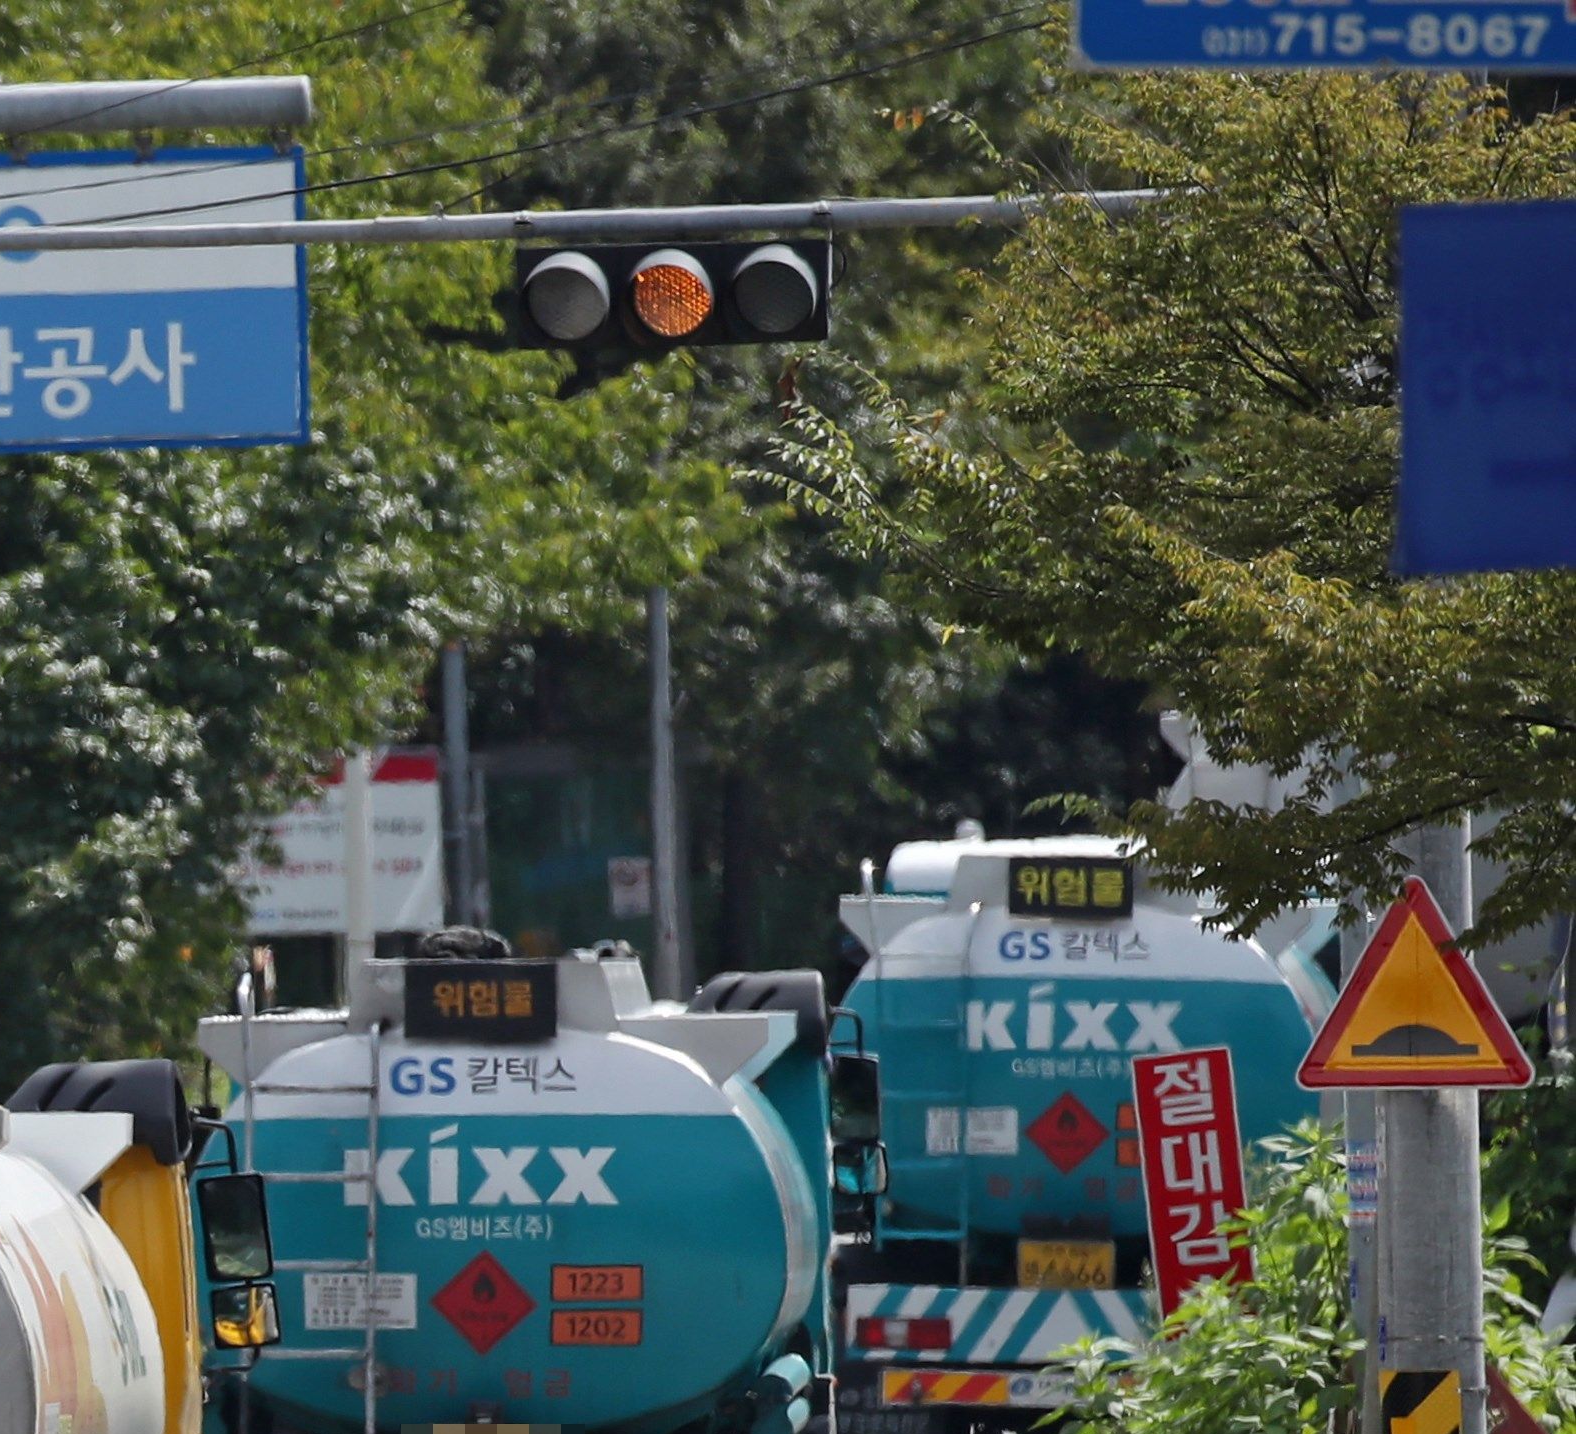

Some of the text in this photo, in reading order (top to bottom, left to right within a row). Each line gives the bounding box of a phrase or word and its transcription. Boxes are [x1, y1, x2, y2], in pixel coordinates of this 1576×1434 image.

[1015, 863, 1126, 909] 위험물
[998, 931, 1152, 963] GS 칼텍스
[432, 979, 536, 1018] 위험물
[390, 1055, 578, 1096] GS 칼텍스
[1153, 1057, 1232, 1283] 절대감
[566, 1271, 626, 1296] 1223
[565, 1316, 627, 1340] 1202
